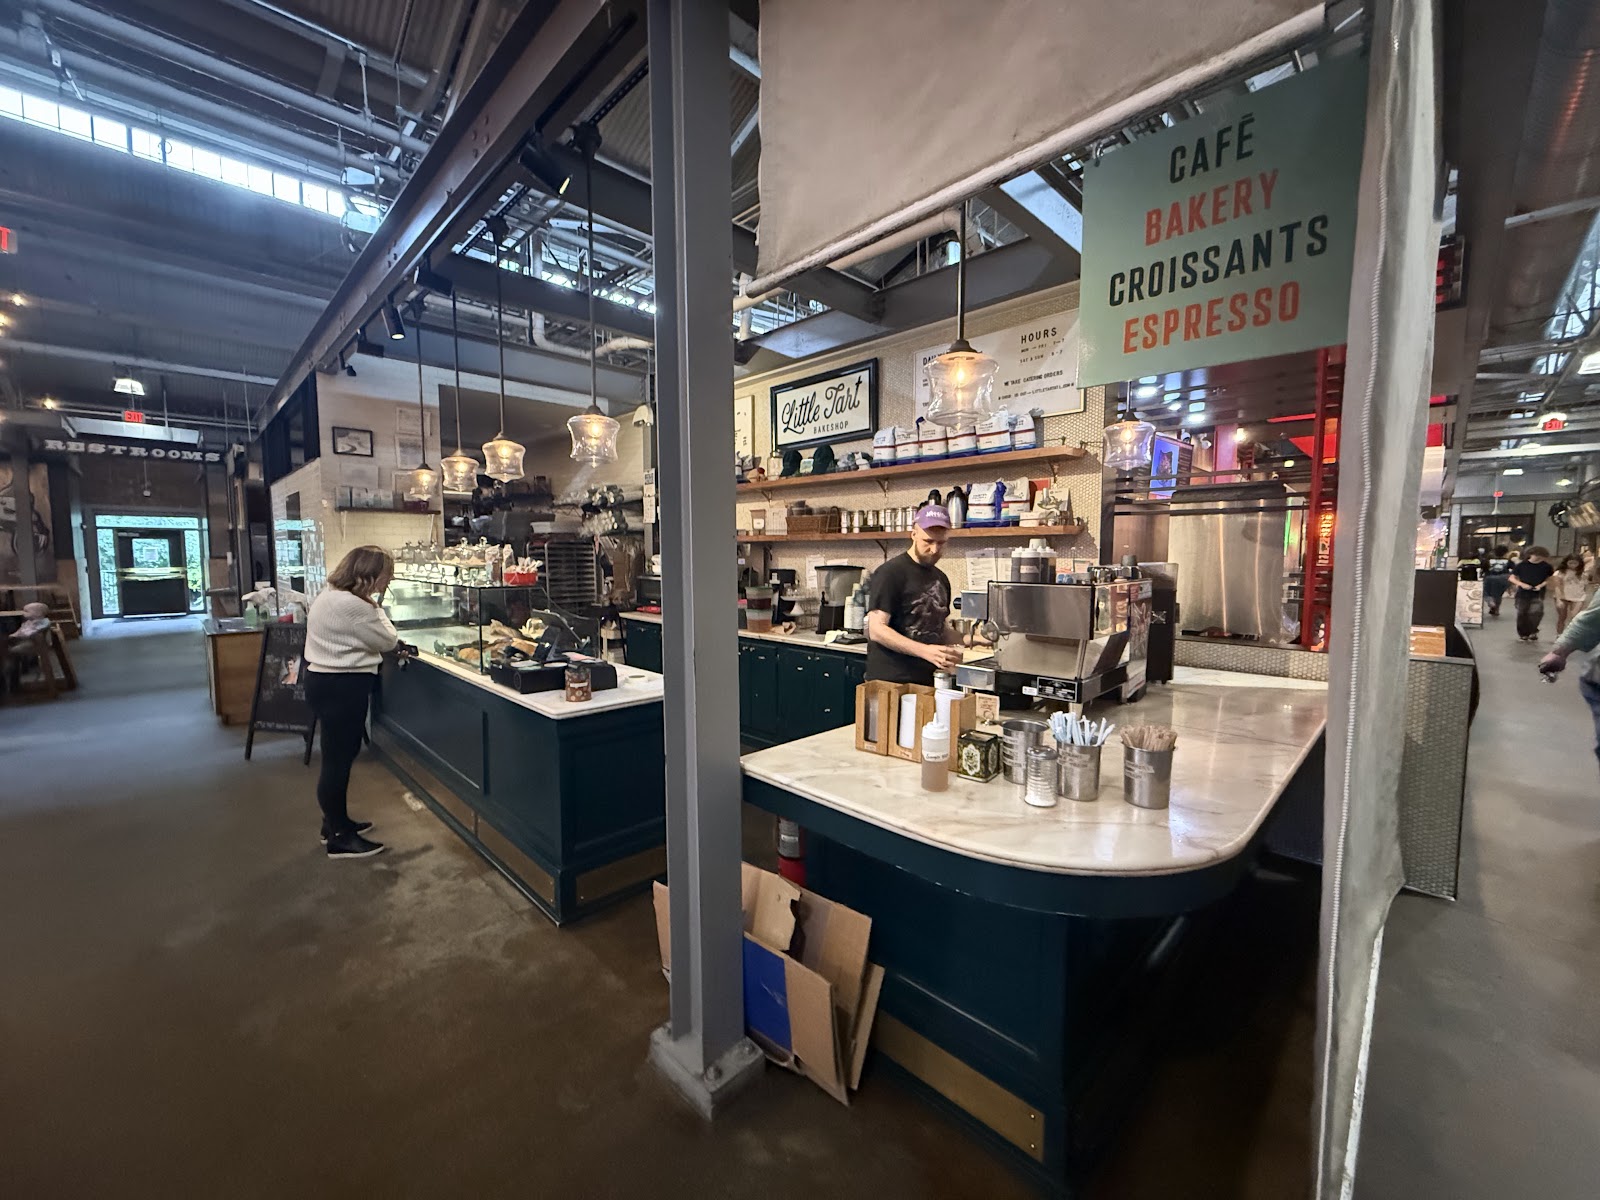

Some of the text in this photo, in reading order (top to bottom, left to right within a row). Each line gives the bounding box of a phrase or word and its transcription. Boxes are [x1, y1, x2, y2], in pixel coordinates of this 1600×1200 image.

[1169, 112, 1255, 184] CAFÉ
[1145, 168, 1279, 246] BAKERY
[1109, 214, 1329, 307] CROISSANTS
[1021, 327, 1057, 344] HOURS
[1123, 281, 1300, 354] ESPRESSO
[1044, 370, 1063, 378] ORDERS
[124, 410, 143, 423] EXIT
[781, 391, 820, 435] Little
[823, 375, 863, 420] Tart
[813, 420, 849, 434] BAKESHOP
[44, 439, 221, 463] RESTROOMS
